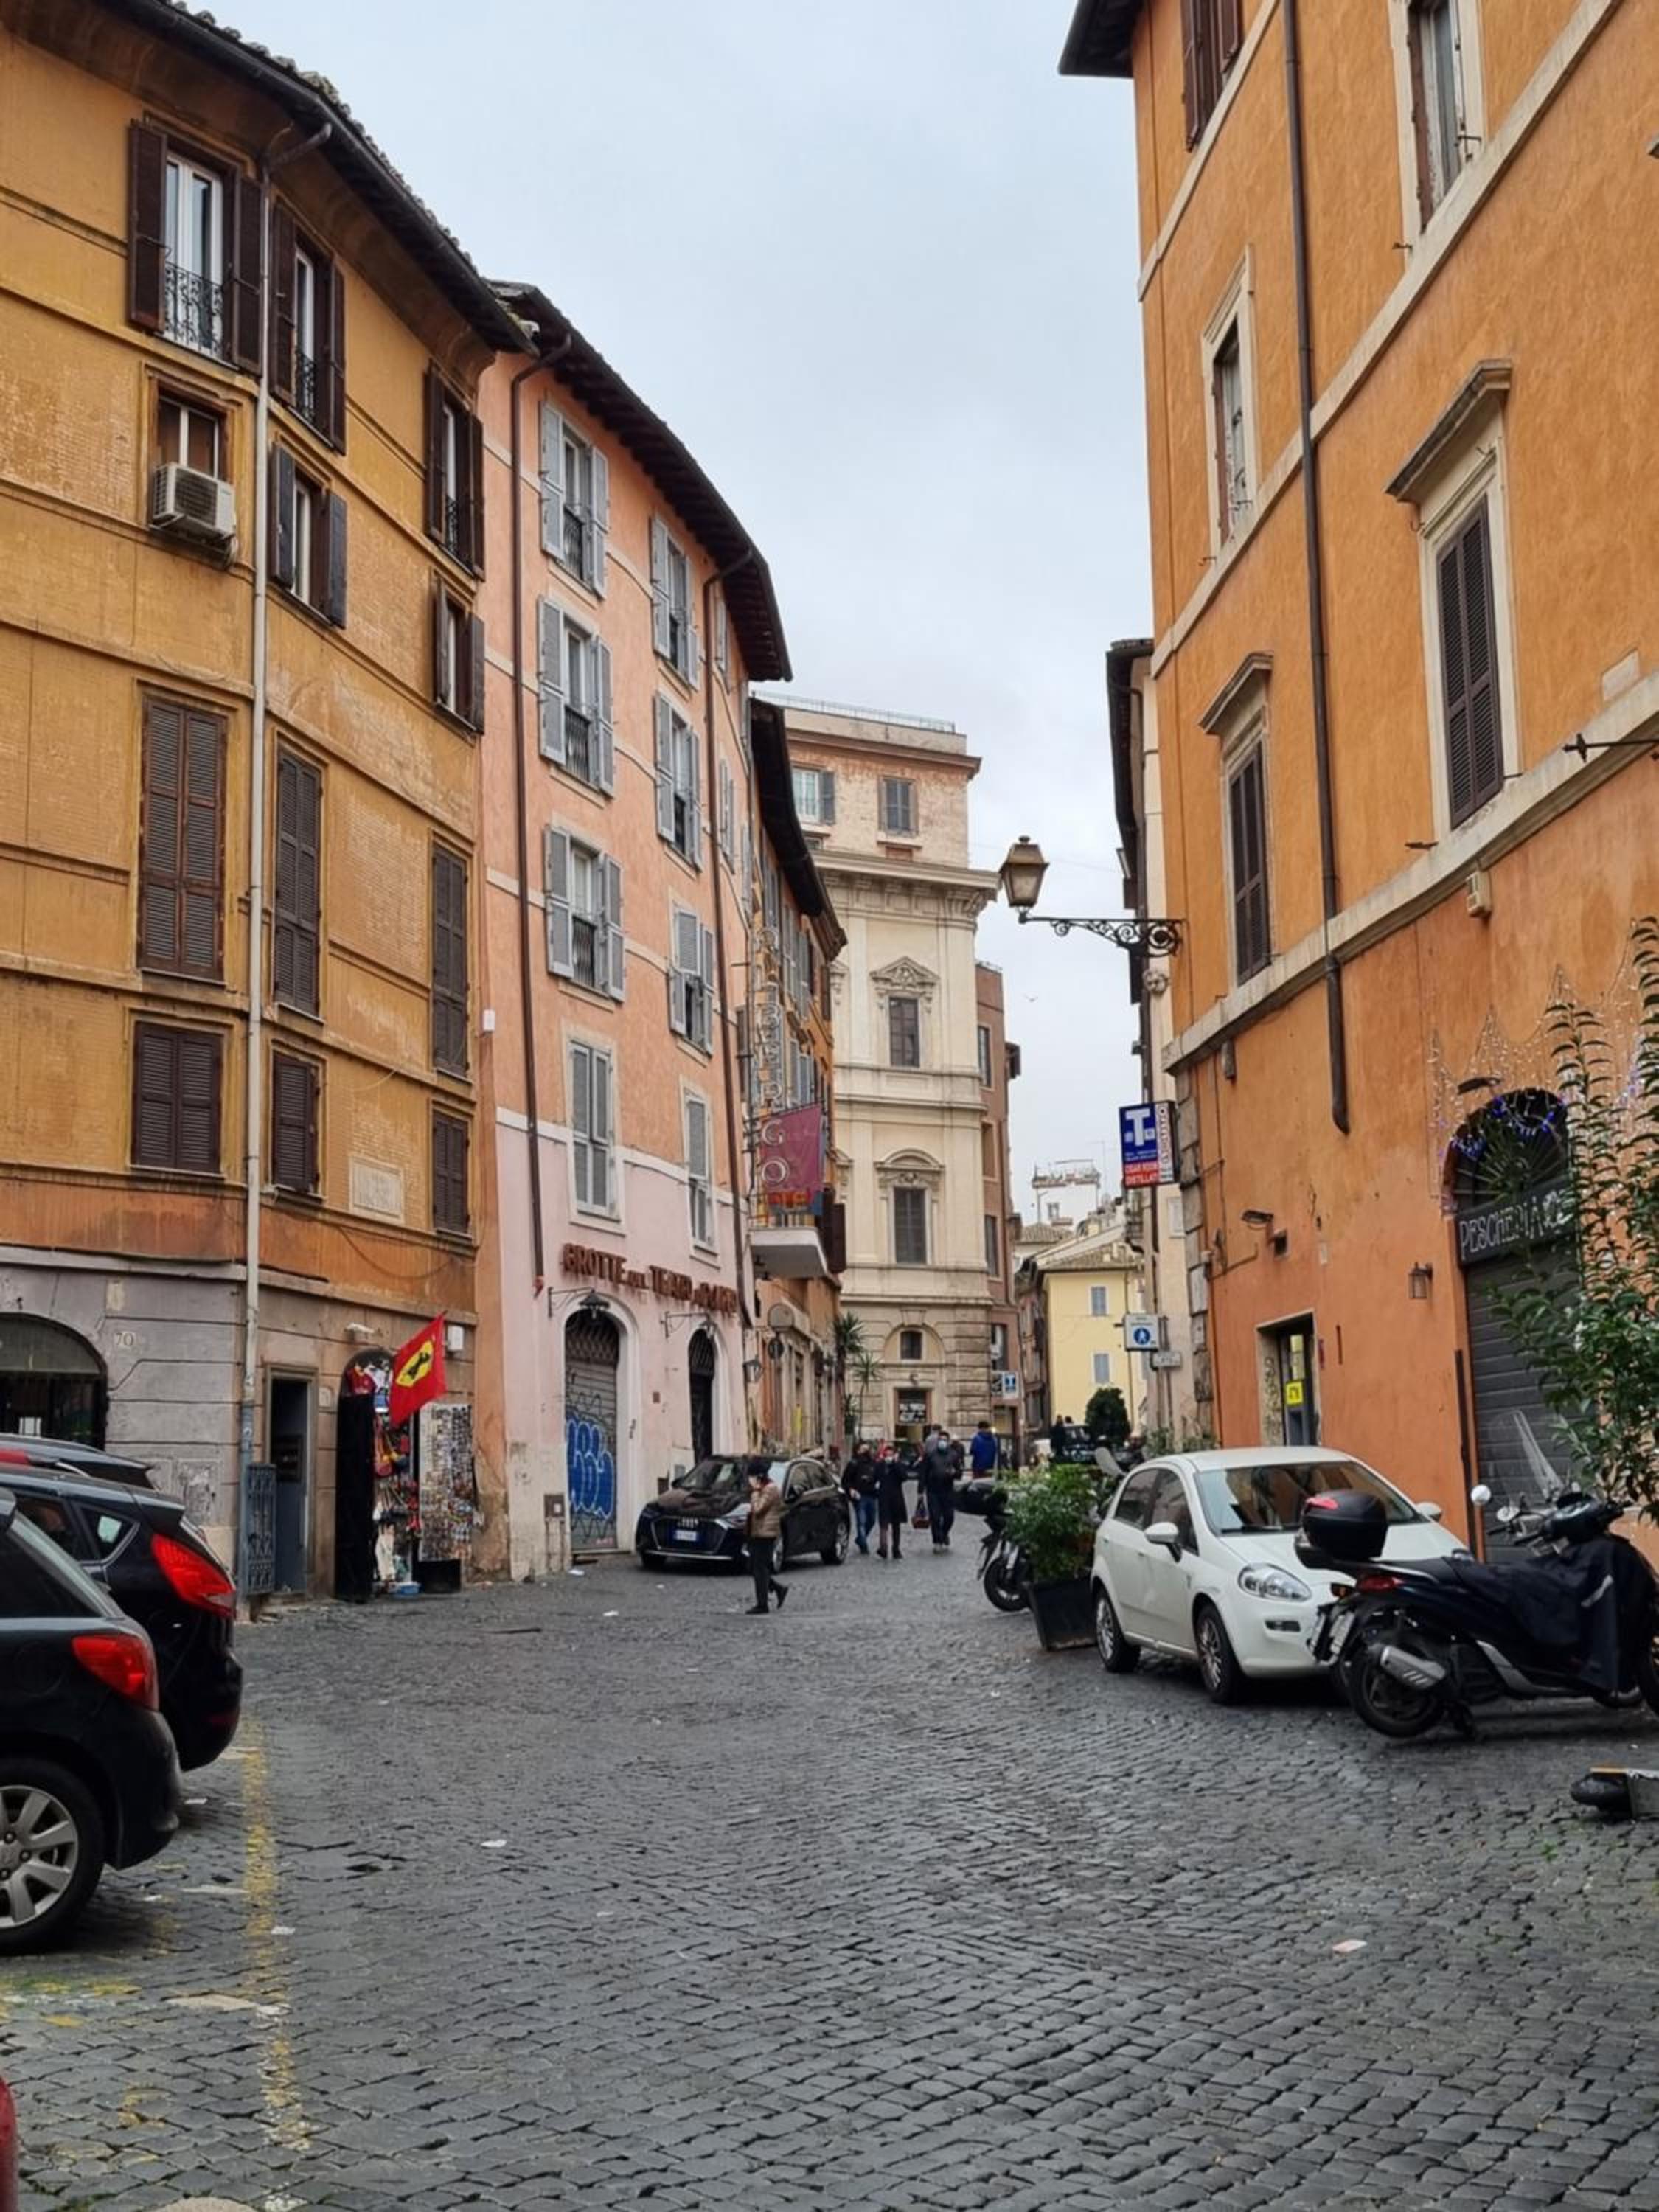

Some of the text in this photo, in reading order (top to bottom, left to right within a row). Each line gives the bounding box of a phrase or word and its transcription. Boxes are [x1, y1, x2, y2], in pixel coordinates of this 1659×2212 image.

[1125, 1109, 1150, 1146] T
[563, 1242, 627, 1284] GROTTE
[116, 1332, 135, 1346] 70
